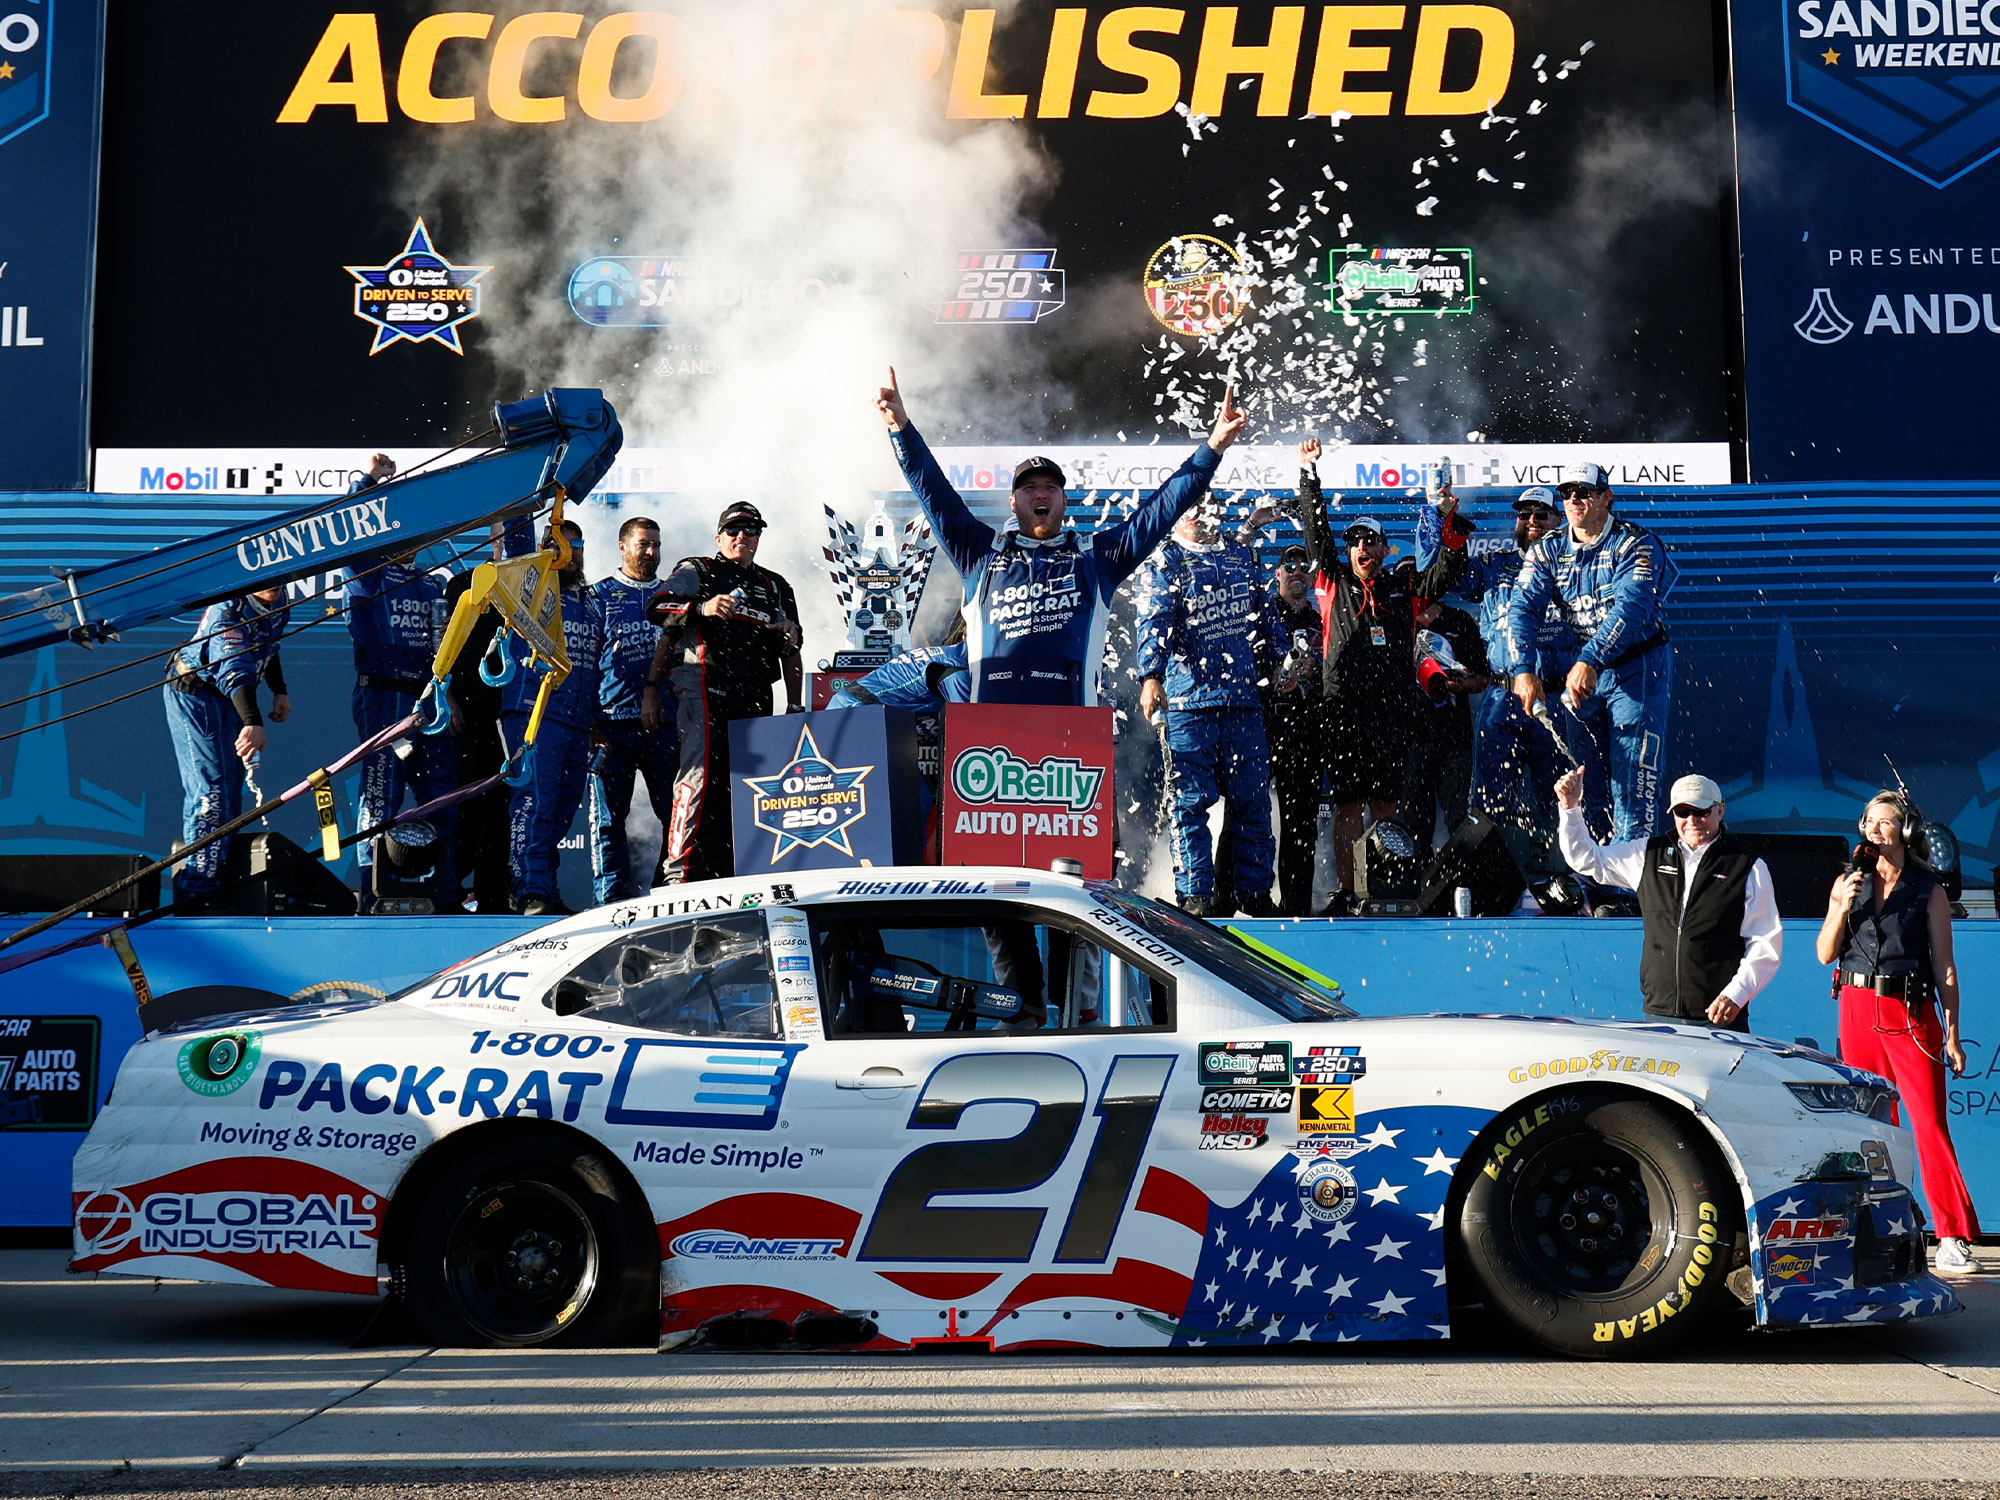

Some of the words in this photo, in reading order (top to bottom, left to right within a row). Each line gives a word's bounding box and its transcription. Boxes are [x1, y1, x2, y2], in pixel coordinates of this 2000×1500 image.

[1798, 0, 1898, 38] SAN
[276, 3, 1515, 124] ACCOPLISHED
[1386, 248, 1431, 260] NASCAR
[414, 269, 448, 278] United
[1426, 265, 1461, 279] AUTO
[363, 289, 416, 301] DRIVEN
[417, 291, 430, 299] TO
[431, 289, 473, 301] SERVE
[957, 271, 1033, 299] 250
[1422, 279, 1465, 292] PARTS
[386, 302, 449, 321] 250
[1163, 289, 1236, 322] 250
[140, 467, 218, 491] Mobil
[295, 469, 378, 489] VICTO
[951, 464, 1016, 490] Mob
[1356, 462, 1432, 488] Mobi
[1512, 465, 1615, 484] VICTY
[1622, 465, 1685, 483] LANE
[237, 496, 390, 571] CENTURY
[991, 582, 1050, 606] 1-800-
[989, 591, 1082, 625] PACK-RAT
[999, 617, 1032, 632] Moving
[1033, 615, 1040, 624] &
[1041, 610, 1074, 623] Storage
[1005, 626, 1031, 640] Made
[1032, 621, 1063, 634] Simple
[1230, 617, 1248, 627] Stora
[805, 774, 832, 784] United
[805, 783, 835, 792] Rentals
[959, 753, 1095, 806] O'Reilly
[761, 795, 807, 811] DRIVEN
[820, 790, 858, 805] SERVE
[782, 806, 838, 829] 250
[954, 811, 1017, 835] AUTO
[1022, 812, 1099, 838] PARTS
[836, 880, 929, 896] AUSTIN
[929, 879, 988, 895] HILL
[647, 893, 733, 919] TITAN
[797, 938, 808, 946] OIL
[431, 971, 530, 1001] DWC
[870, 976, 912, 990] PACK-RAT
[470, 1030, 615, 1059] 1-800-
[1235, 1042, 1265, 1050] NASCAR
[22, 1049, 76, 1070] AUTO
[1207, 1054, 1257, 1073] O'Reilly
[1258, 1063, 1285, 1072] PARTS
[1261, 1054, 1284, 1063] AUTO
[1310, 1057, 1350, 1073] 250
[14, 1071, 80, 1092] PARTS
[179, 1055, 190, 1073] GET
[186, 1073, 247, 1094] BIOETHANOL
[1233, 1077, 1258, 1085] SERIES
[259, 1060, 604, 1119] PACK-RAT
[1203, 1091, 1292, 1109] COMETIC
[1202, 1114, 1268, 1136] Holley
[1300, 1123, 1351, 1131] KENNAMETAL
[200, 1121, 290, 1151] Moving
[293, 1126, 313, 1148] &
[317, 1125, 417, 1156] Storage
[1199, 1134, 1259, 1150] MSD
[1296, 1140, 1324, 1149] FIVE
[1327, 1140, 1355, 1149] STAR
[1483, 1104, 1550, 1182] EAGLE
[633, 1142, 706, 1166] Made
[710, 1143, 804, 1173] Simple
[856, 1051, 1179, 1264] 21
[1860, 1139, 1897, 1181] 21
[1304, 1165, 1350, 1184] CHAMPION
[144, 1197, 372, 1227] GLOBAL
[1304, 1199, 1352, 1220] IRRIGATION
[144, 1228, 371, 1250] INDUSTRIAL
[689, 1240, 842, 1255] BENNETT
[1769, 1260, 1812, 1274] SUNOCO
